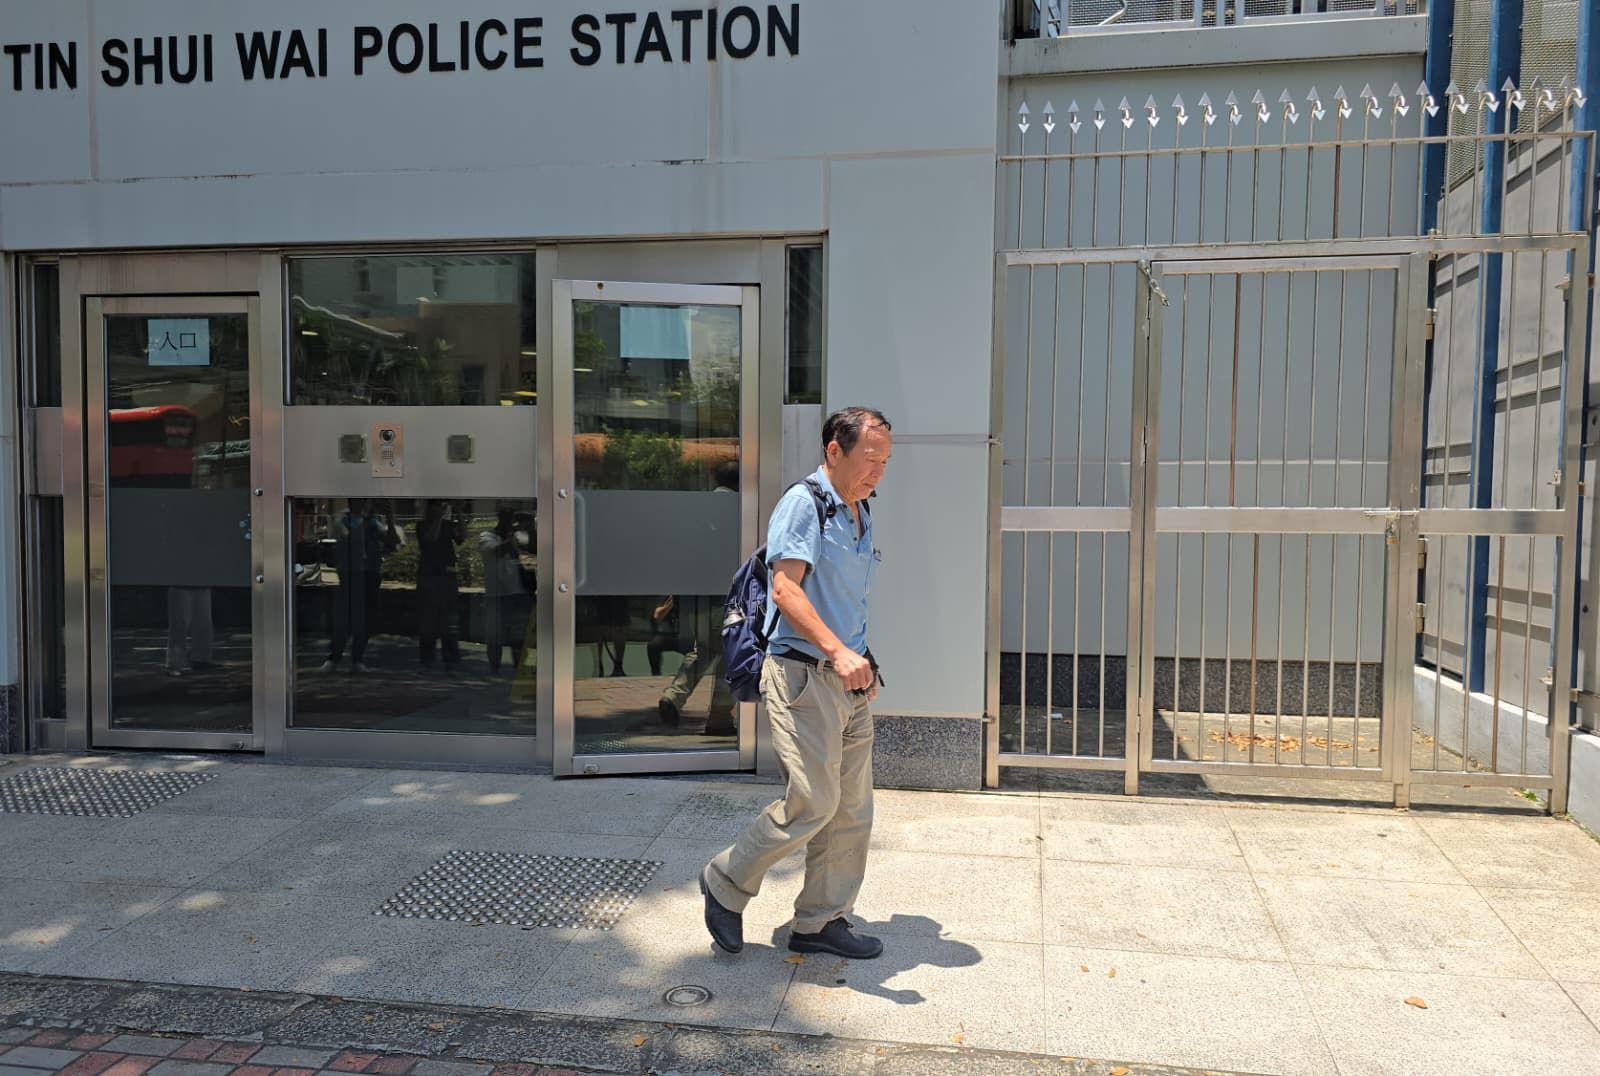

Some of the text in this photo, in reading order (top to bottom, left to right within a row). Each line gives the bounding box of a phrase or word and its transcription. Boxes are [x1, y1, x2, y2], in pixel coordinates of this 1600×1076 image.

[3, 3, 801, 92] TIN SHUI WAI POLICE STATION
